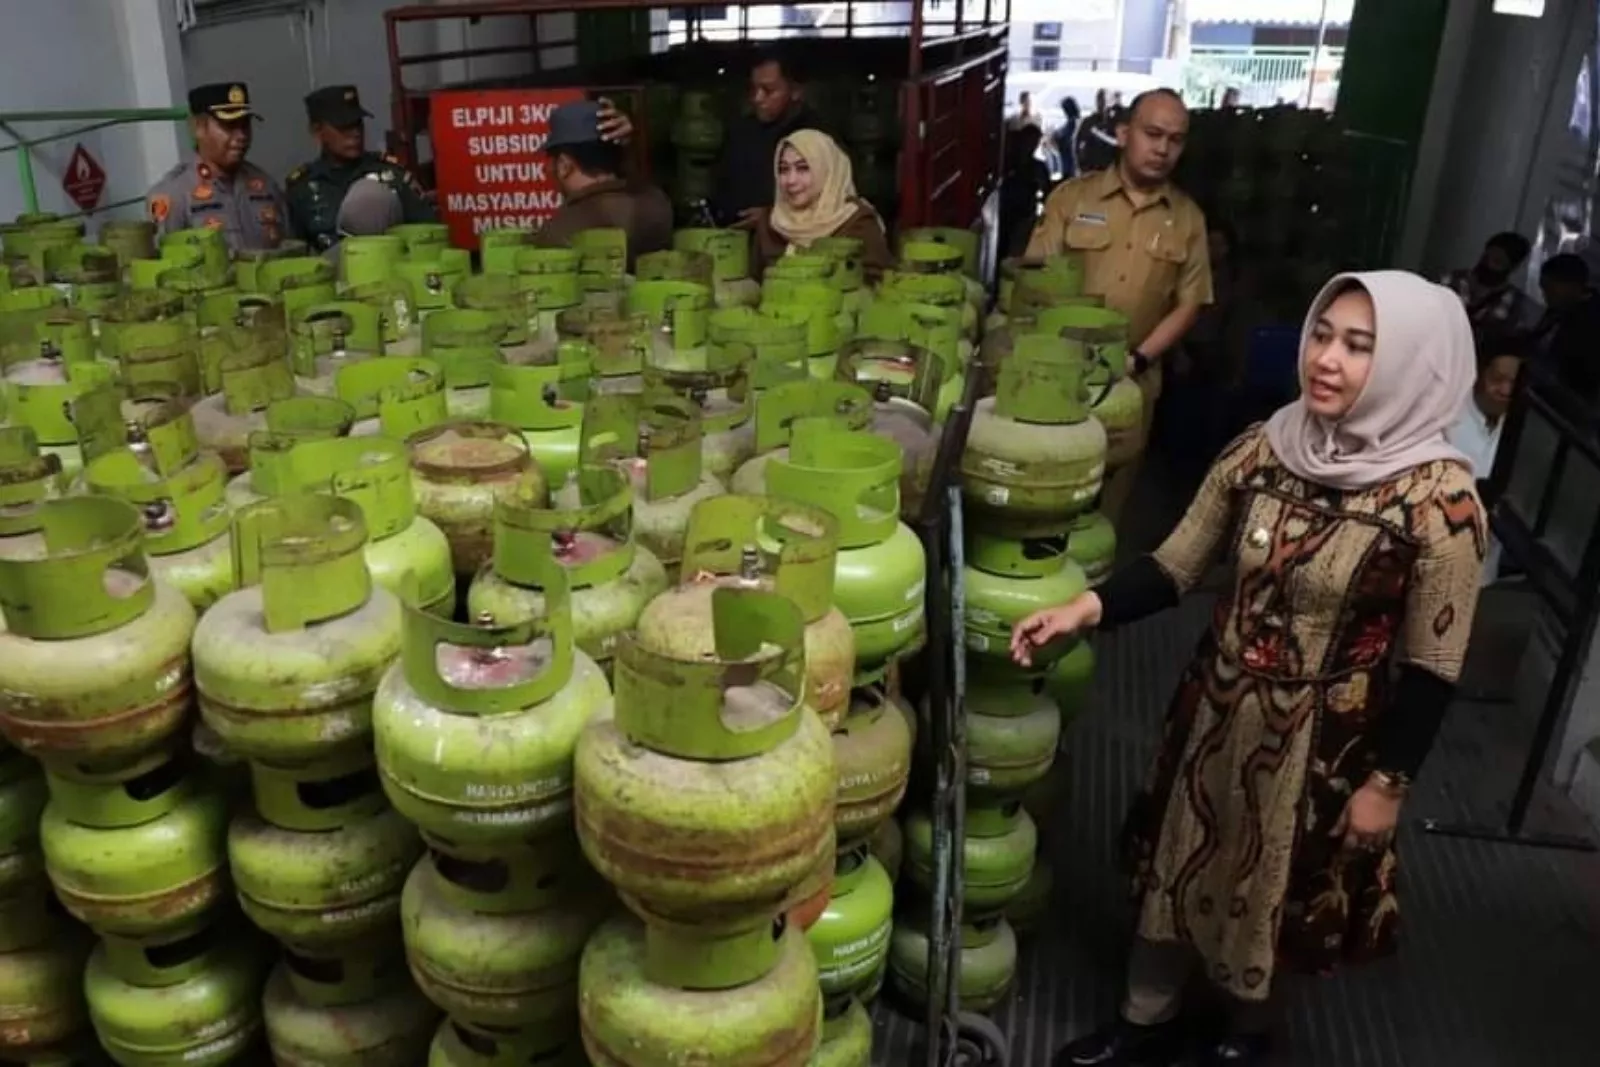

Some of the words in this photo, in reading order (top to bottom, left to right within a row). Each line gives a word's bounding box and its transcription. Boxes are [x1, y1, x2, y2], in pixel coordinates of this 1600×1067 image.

[452, 105, 514, 128] ELPIJI
[475, 161, 546, 184] UNTUK
[472, 214, 552, 234] MISKI
